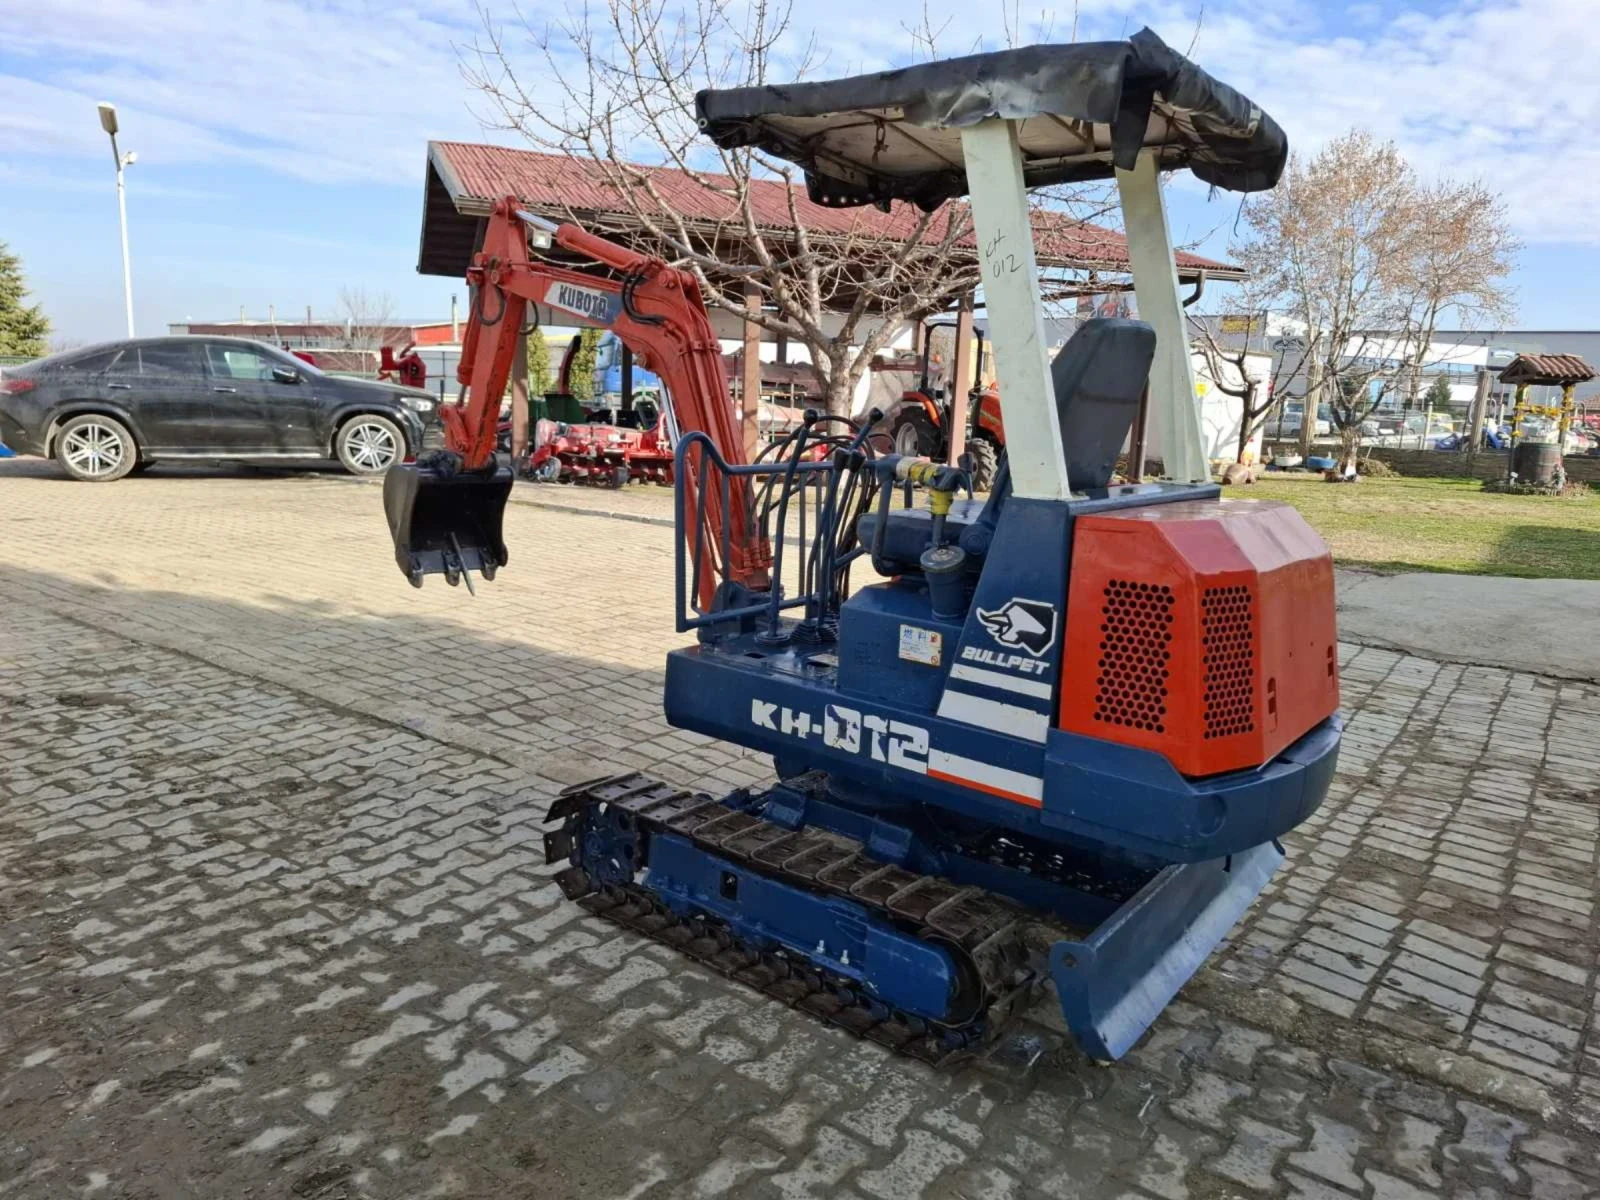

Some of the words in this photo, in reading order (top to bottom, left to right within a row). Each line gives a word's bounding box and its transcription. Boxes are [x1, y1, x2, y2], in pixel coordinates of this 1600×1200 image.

[992, 254, 1024, 278] 012
[558, 284, 608, 319] KUBOTA
[961, 645, 1050, 675] BULLPET
[751, 698, 929, 775] KH-012
